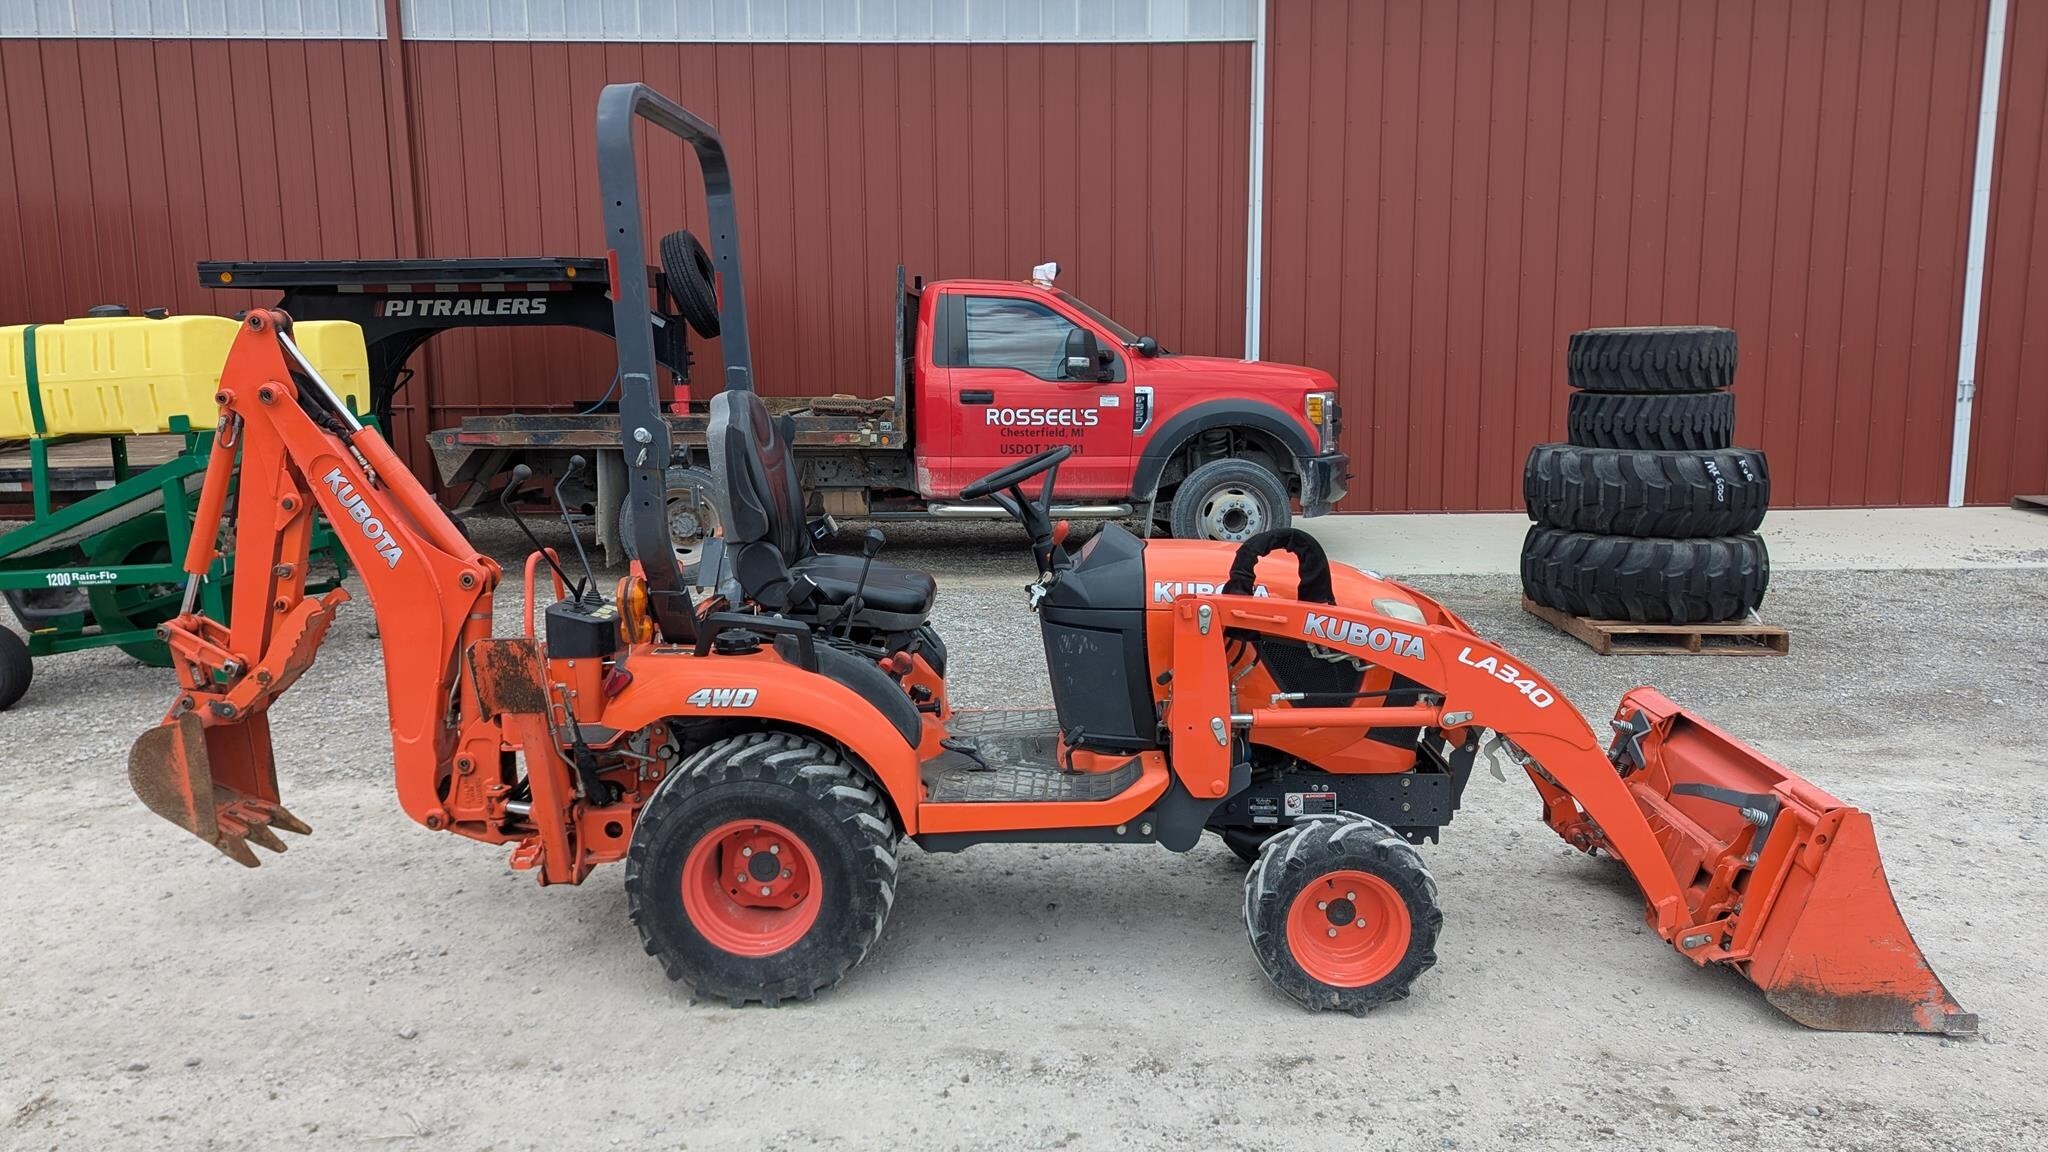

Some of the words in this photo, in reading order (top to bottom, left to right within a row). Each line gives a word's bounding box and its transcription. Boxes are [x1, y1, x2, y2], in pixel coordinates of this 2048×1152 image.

[384, 300, 413, 316] PJ
[417, 298, 547, 316] TRAILERS
[986, 408, 1099, 426] ROSSEEL'S
[1000, 428, 1067, 438] Chesterfield,
[1071, 429, 1084, 437] MI
[1000, 444, 1040, 454] USDOT
[322, 466, 403, 569] KUBOTA
[46, 573, 71, 586] 1200
[71, 571, 117, 581] Rain-Flo
[1154, 581, 1270, 603] KUBA
[1303, 612, 1426, 661] KUBOTA
[1457, 646, 1555, 709] LA340
[685, 688, 758, 708] 4WD
